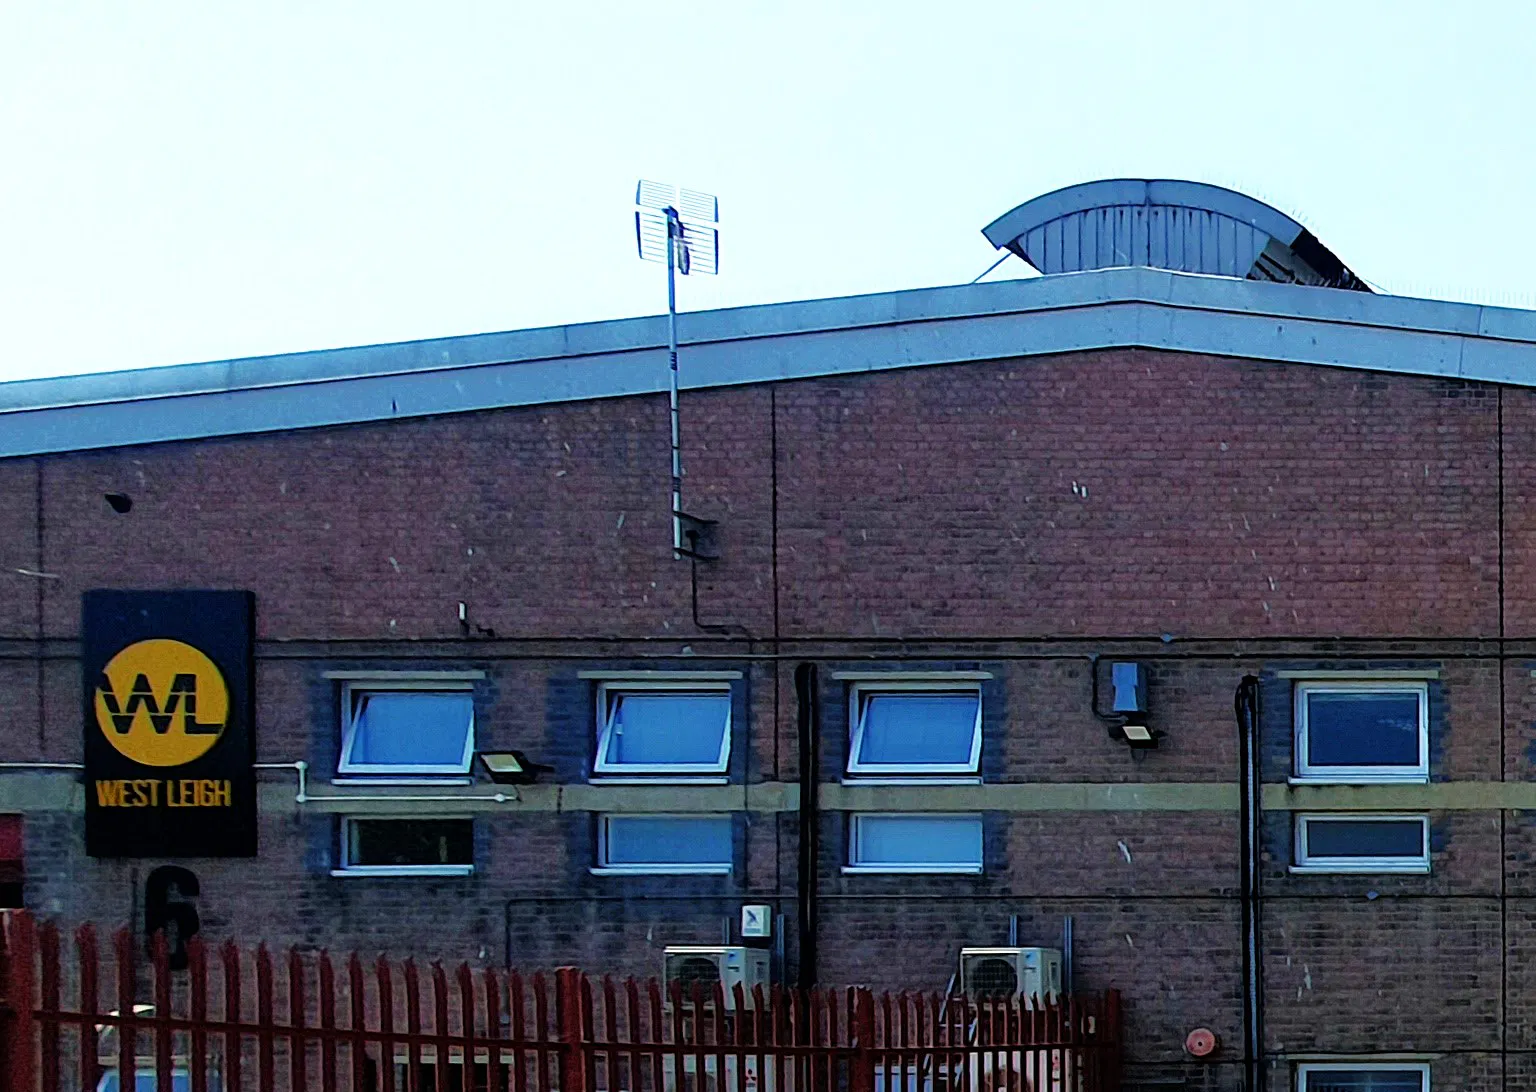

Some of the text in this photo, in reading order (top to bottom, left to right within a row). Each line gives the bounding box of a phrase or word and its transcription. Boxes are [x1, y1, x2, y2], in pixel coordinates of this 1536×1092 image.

[101, 674, 224, 735] WL
[96, 779, 232, 807] WEST LEIGH
[145, 865, 200, 971] 6
